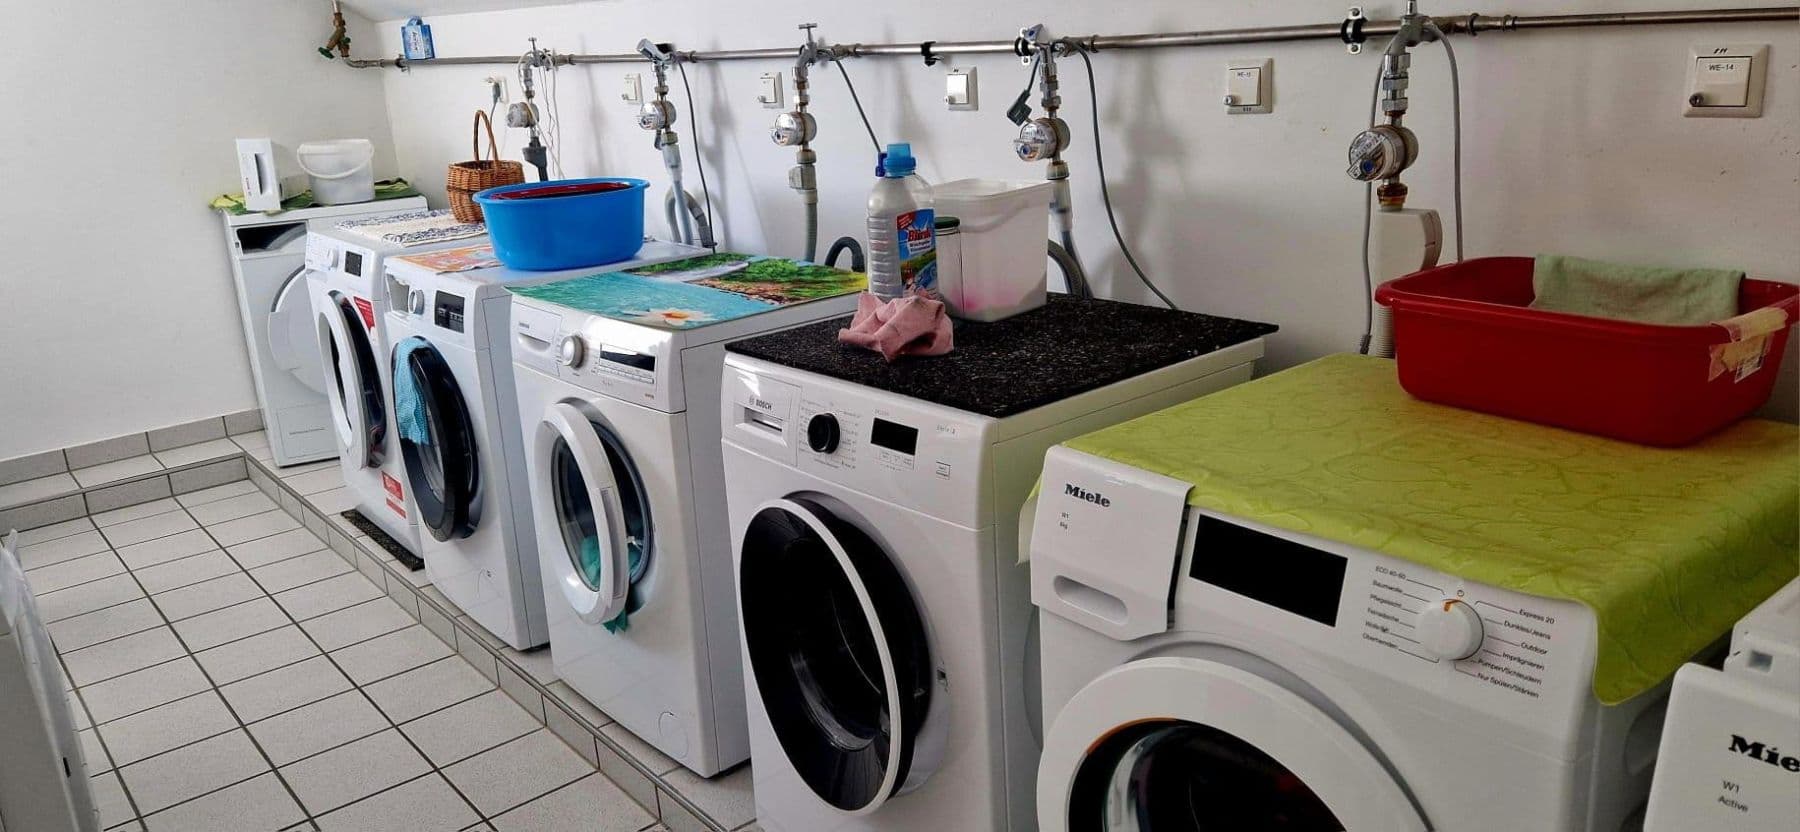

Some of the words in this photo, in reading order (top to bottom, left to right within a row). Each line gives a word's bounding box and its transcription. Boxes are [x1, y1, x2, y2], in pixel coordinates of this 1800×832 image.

[755, 399, 772, 410] BOSCH
[1064, 483, 1111, 508] Miele
[1519, 608, 1544, 622] Express
[1545, 617, 1555, 625] 20
[1520, 642, 1549, 655] Outdoor
[1727, 734, 1800, 773] Mie
[1723, 780, 1740, 793] W1
